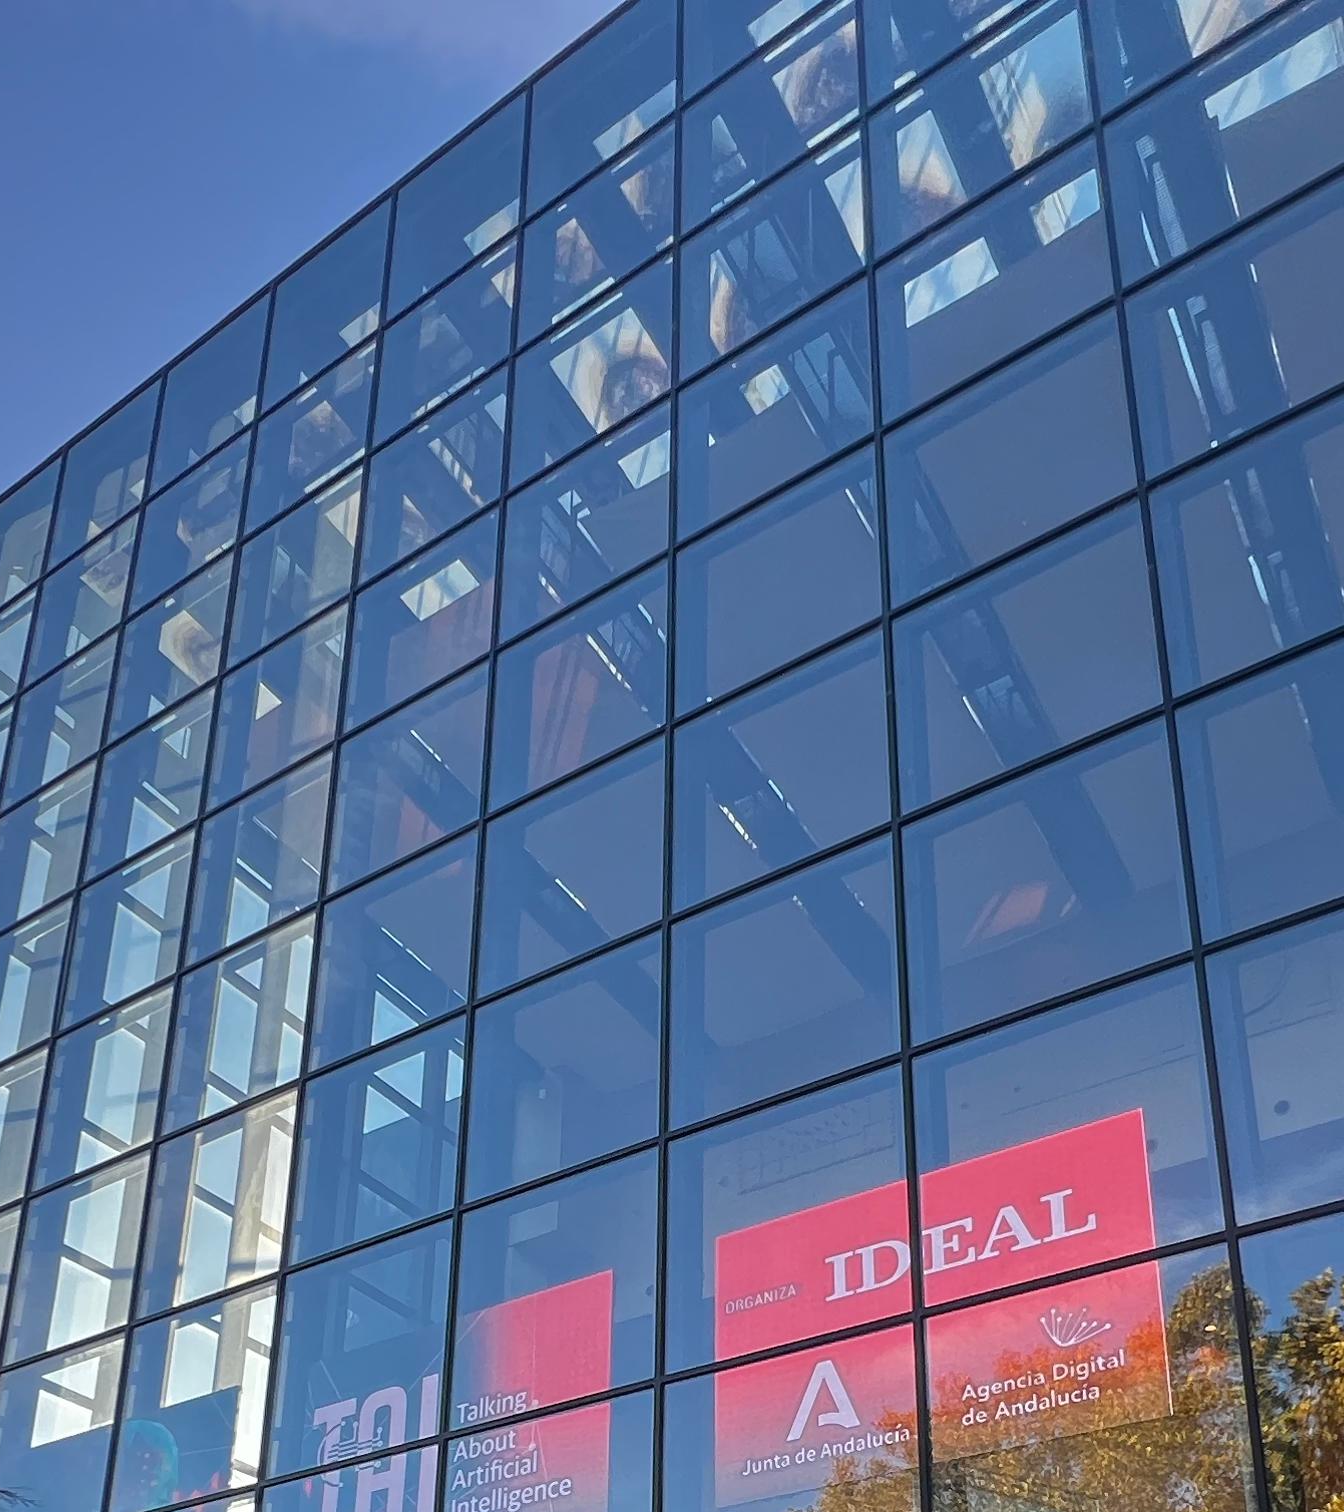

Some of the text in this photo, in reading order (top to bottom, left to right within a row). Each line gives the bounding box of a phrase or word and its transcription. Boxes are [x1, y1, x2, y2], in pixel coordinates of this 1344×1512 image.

[724, 1188, 1098, 1315] ORGANIZA IDEAL
[961, 1349, 1127, 1403] Agencia Digital
[457, 1389, 529, 1424] Talking
[961, 1383, 1102, 1428] de Andalucía
[453, 1429, 518, 1462] About
[742, 1423, 911, 1477] Junta de Andalucía
[452, 1450, 539, 1491] Artificial
